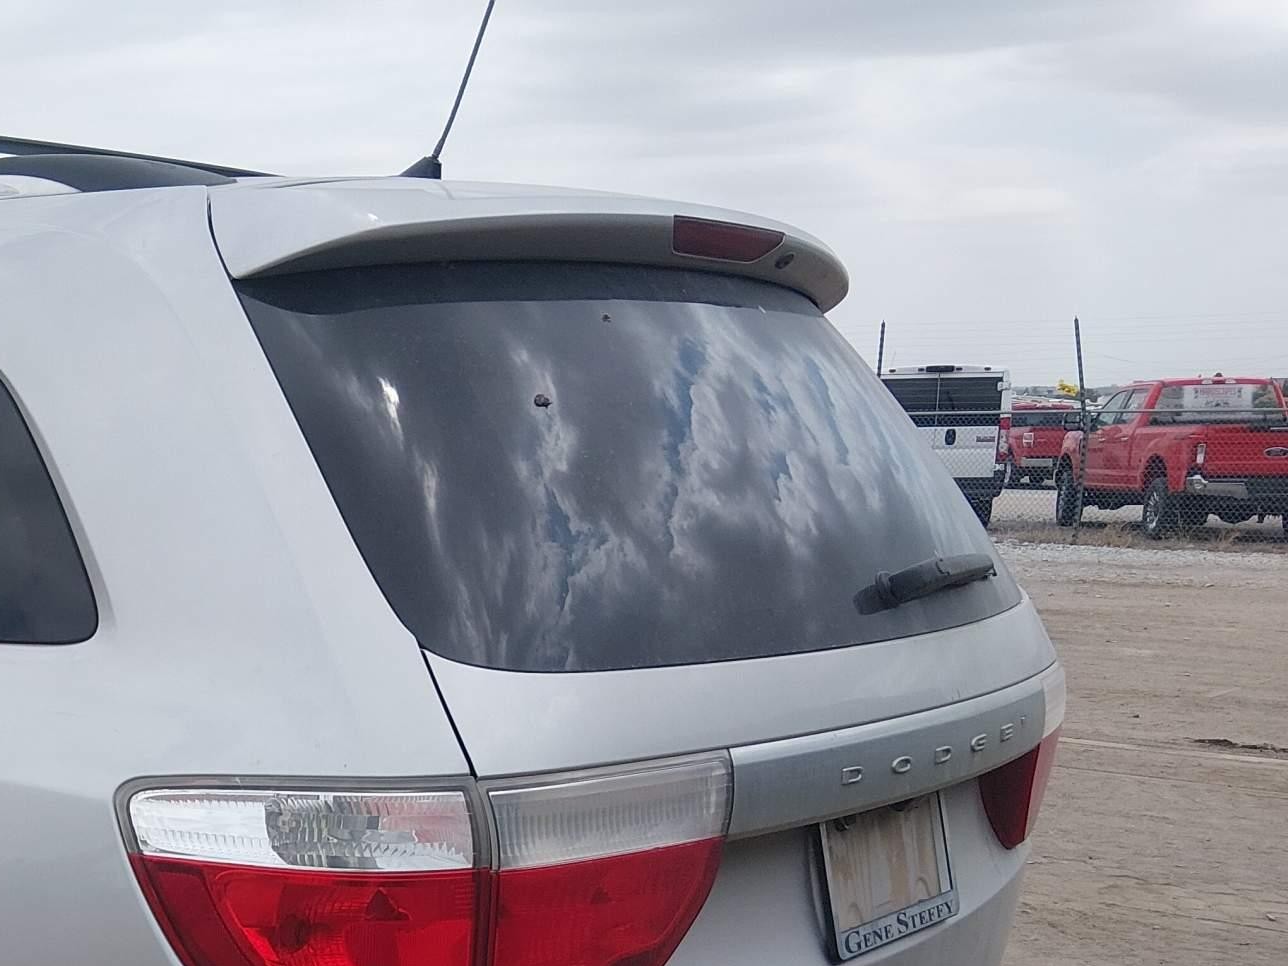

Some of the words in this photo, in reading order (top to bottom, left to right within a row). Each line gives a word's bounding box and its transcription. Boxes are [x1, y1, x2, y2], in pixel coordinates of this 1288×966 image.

[840, 722, 1014, 785] DODGE
[844, 924, 895, 955] GENE
[896, 899, 955, 935] STEFFY
